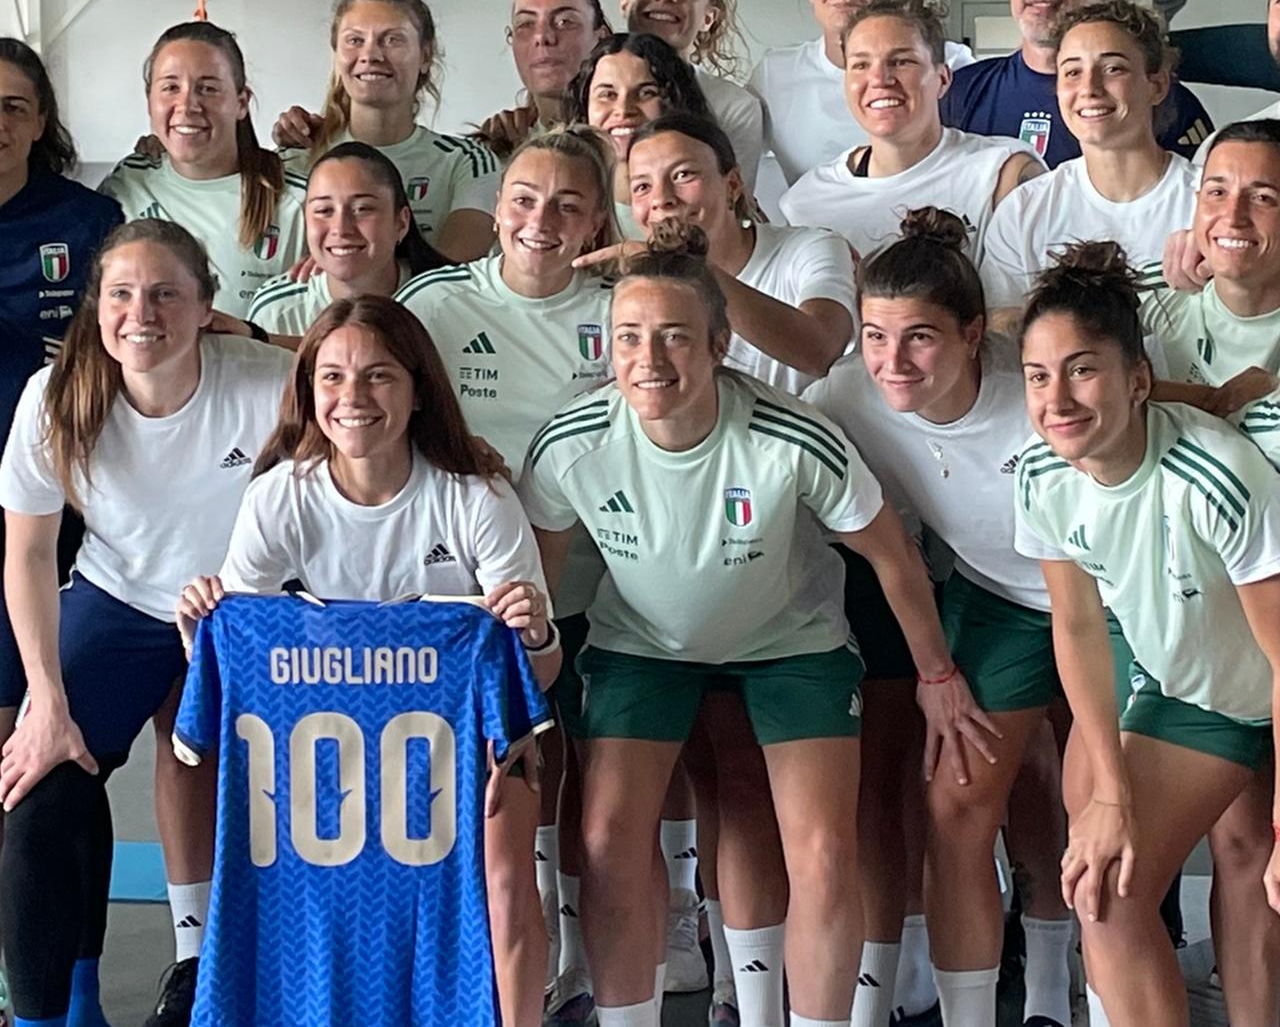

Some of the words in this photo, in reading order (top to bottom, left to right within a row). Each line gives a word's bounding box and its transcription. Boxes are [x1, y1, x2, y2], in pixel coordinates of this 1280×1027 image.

[473, 367, 499, 381] TIM
[459, 383, 498, 399] Poste
[612, 530, 639, 546] TIM
[599, 540, 640, 560] Poste
[269, 646, 439, 685] GIUGLIANO
[235, 710, 458, 869] 100
